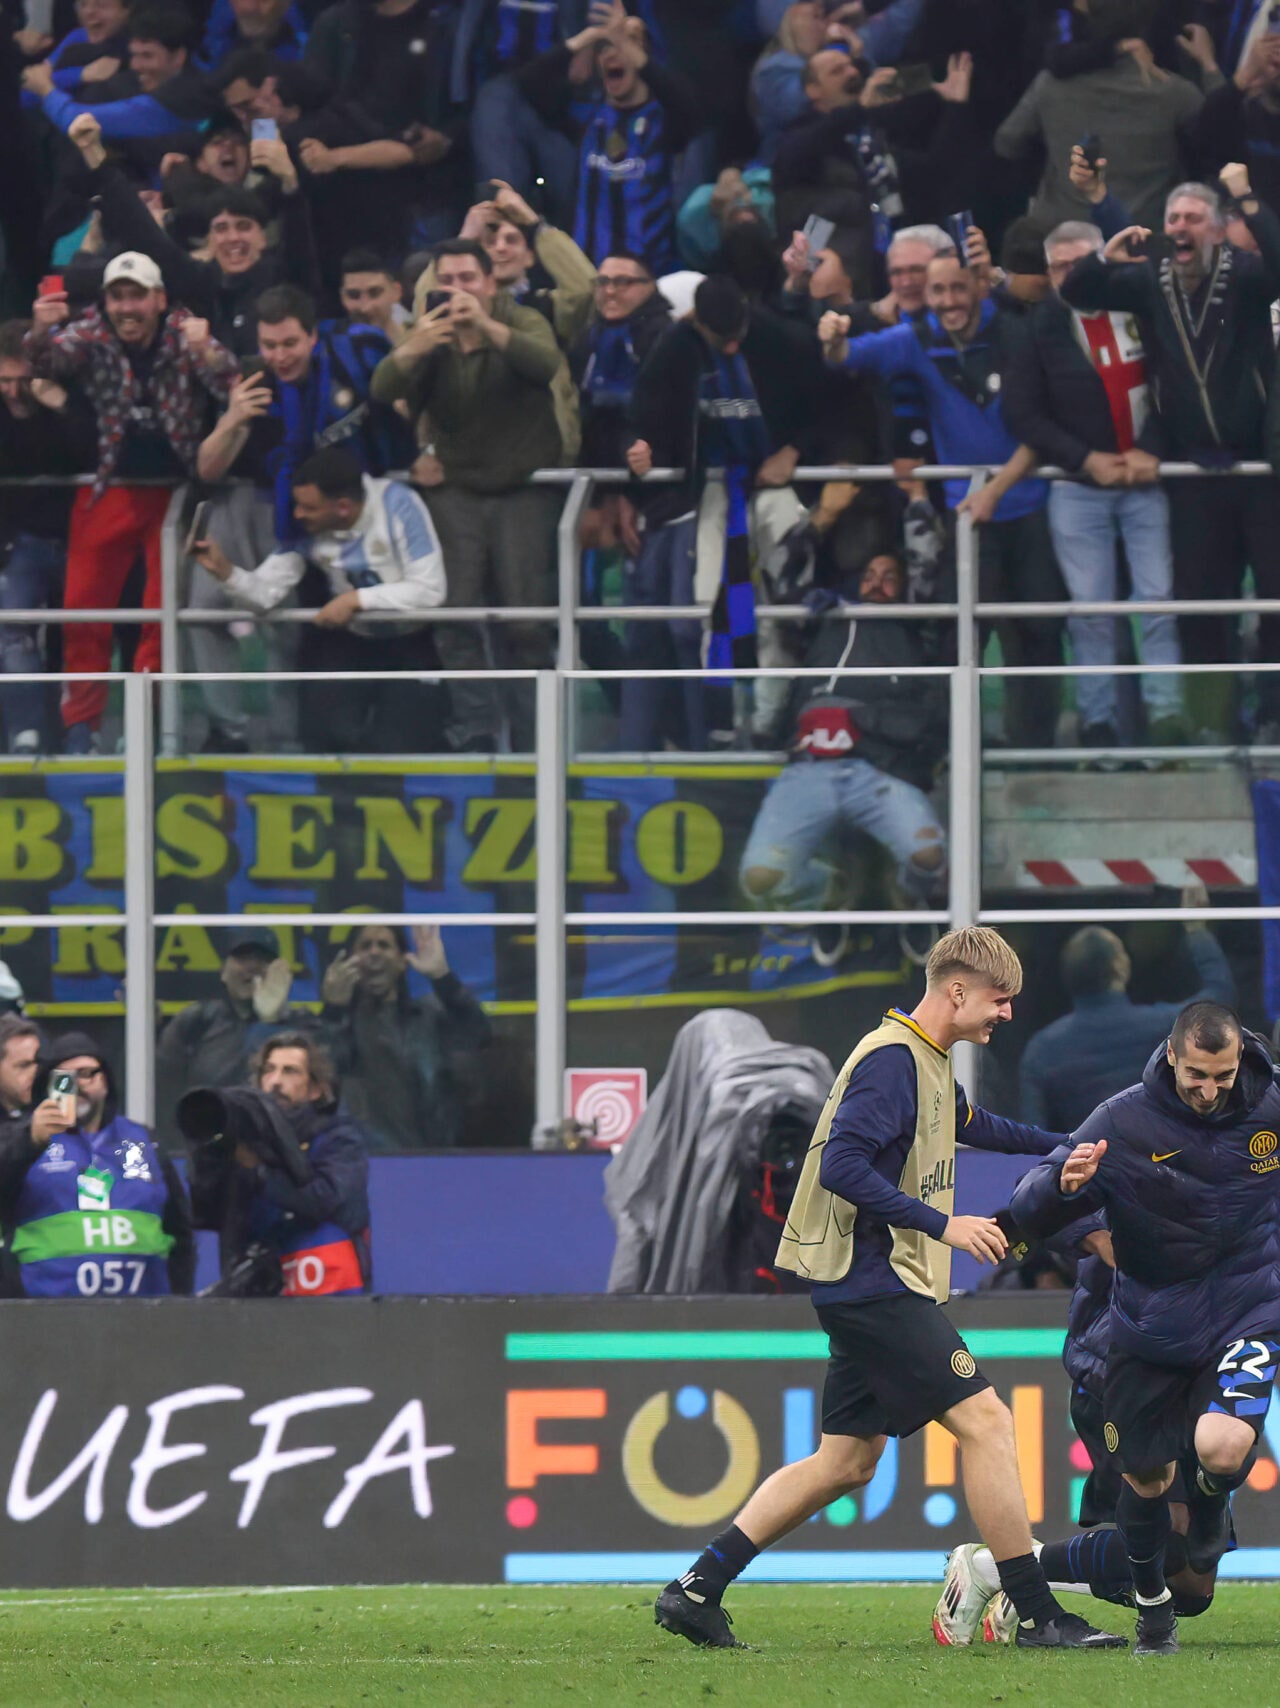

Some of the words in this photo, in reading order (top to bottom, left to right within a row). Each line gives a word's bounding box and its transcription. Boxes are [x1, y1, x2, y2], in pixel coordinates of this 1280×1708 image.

[0, 792, 723, 885] BISENZIO
[1250, 1156, 1280, 1172] QATAR
[82, 1215, 137, 1247] HB
[76, 1261, 146, 1296] 057
[1216, 1338, 1270, 1380] 22
[6, 1385, 457, 1530] UEFA
